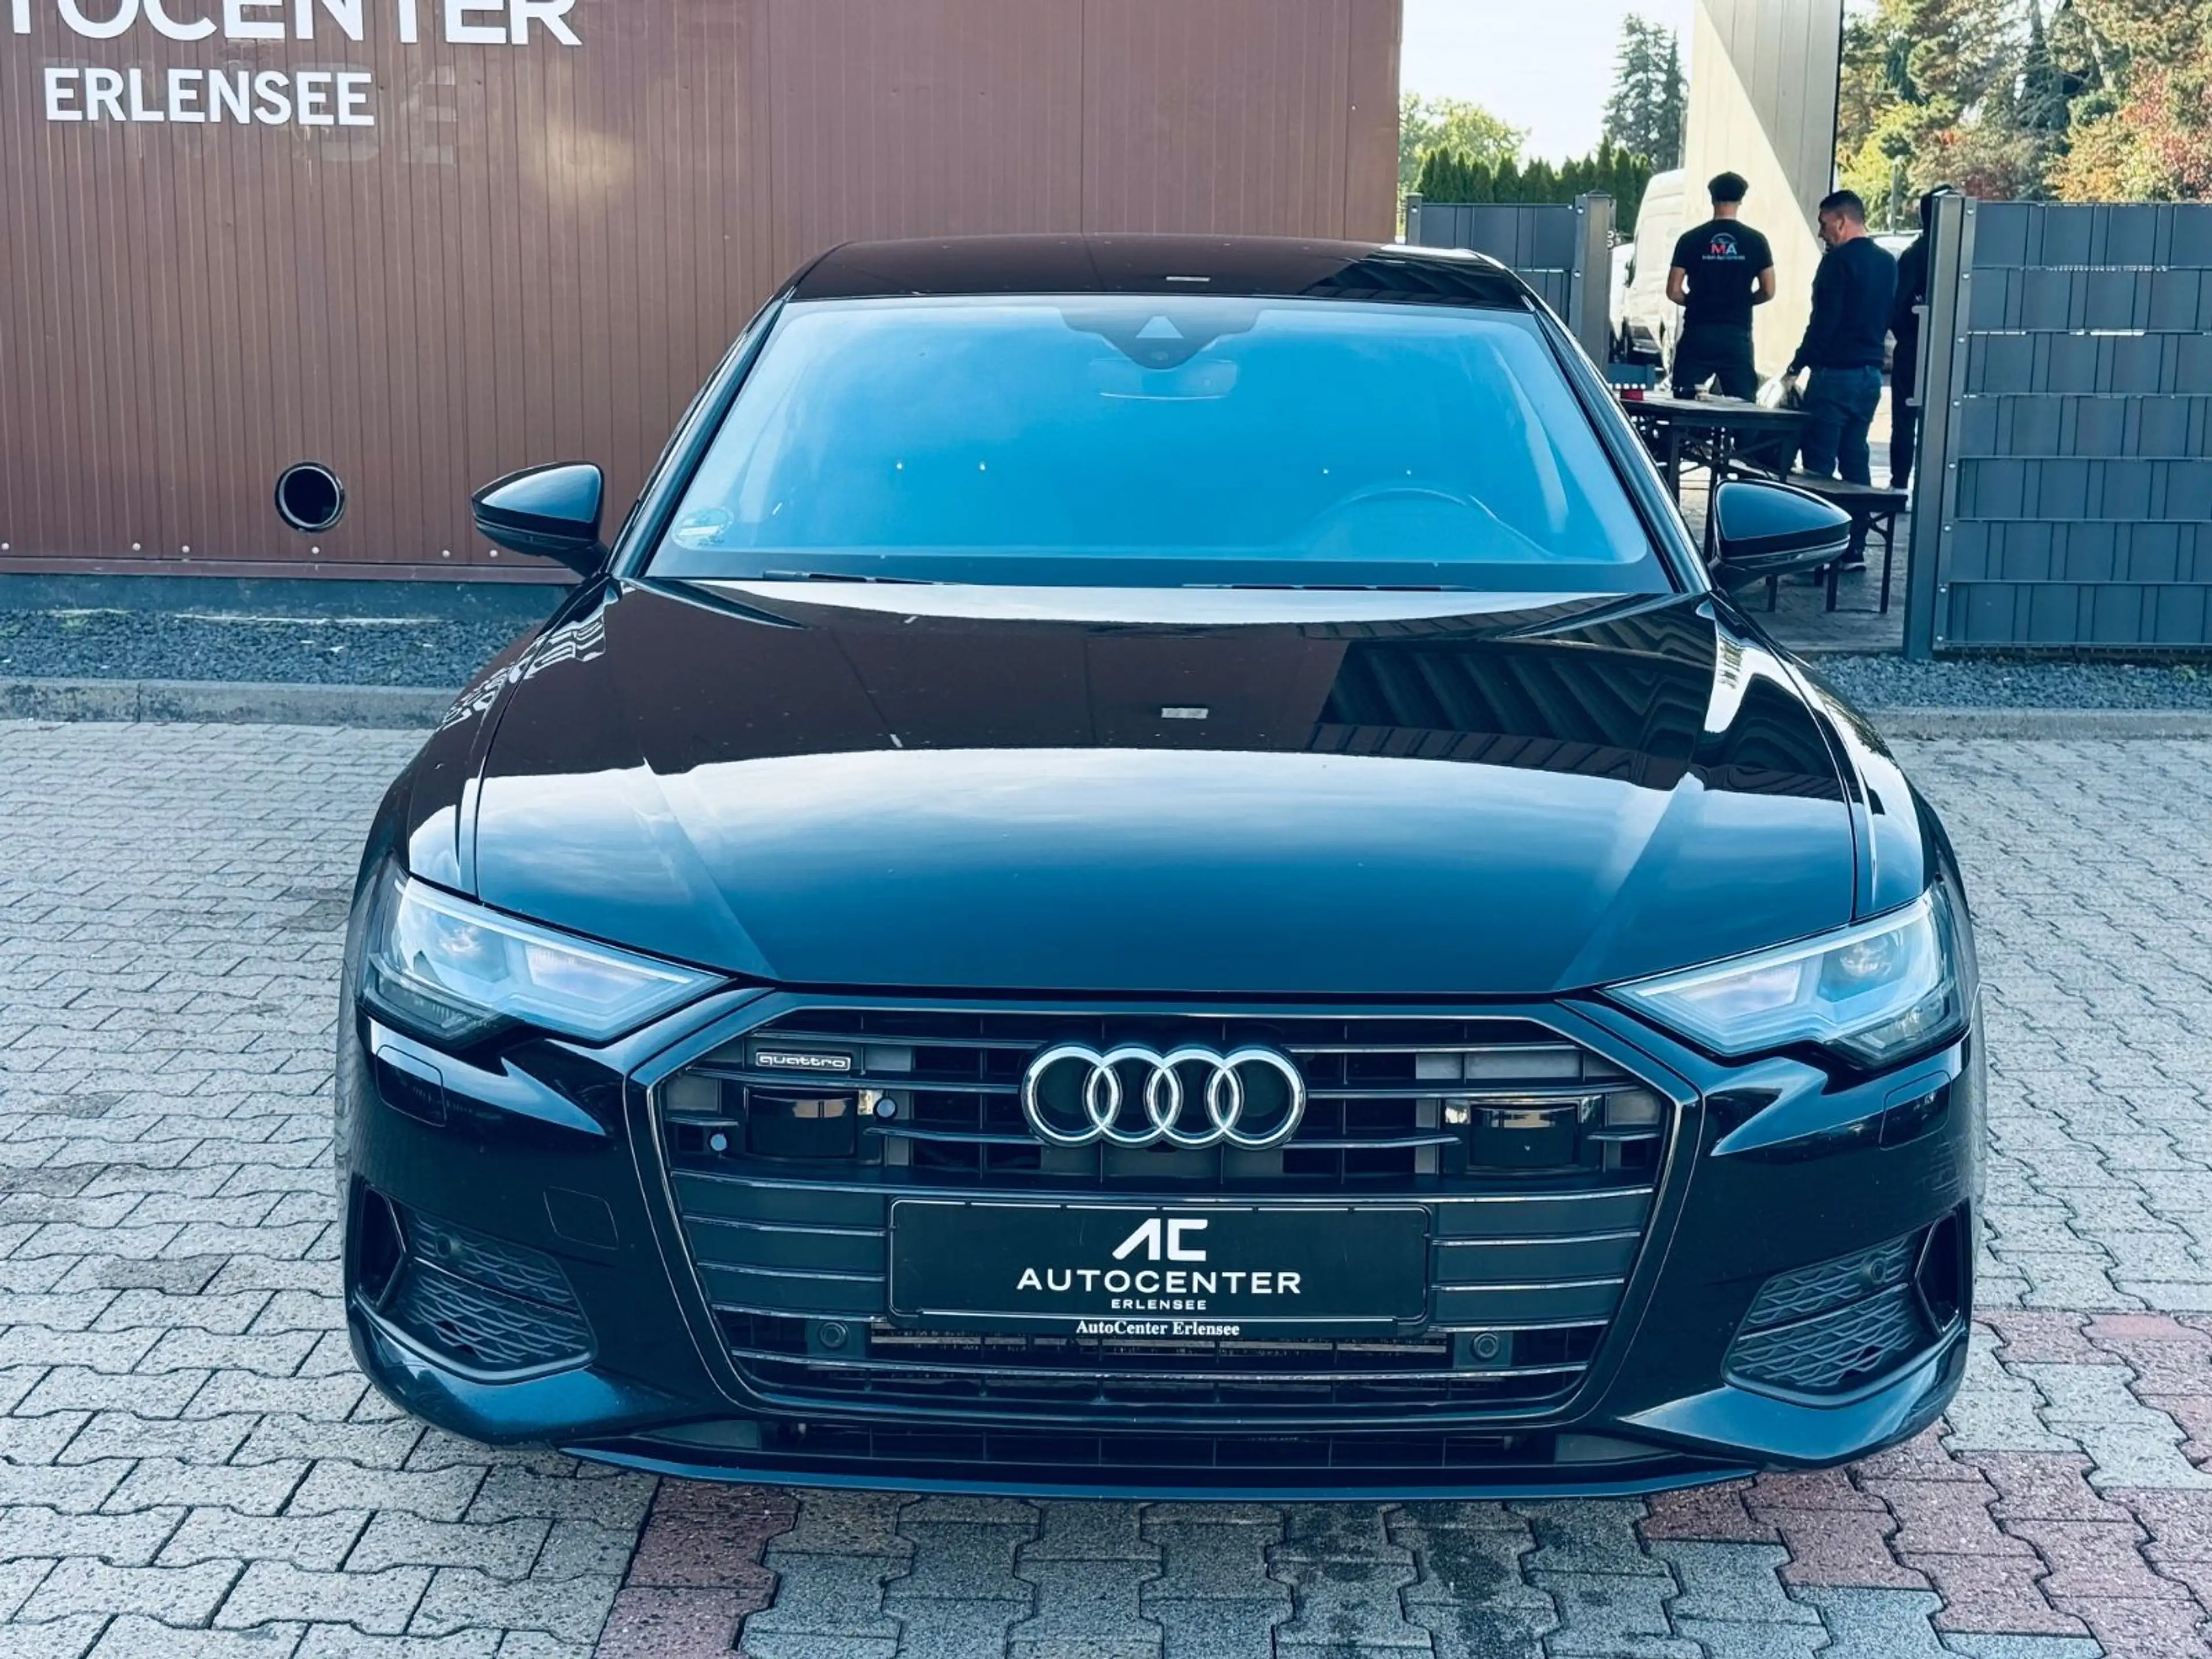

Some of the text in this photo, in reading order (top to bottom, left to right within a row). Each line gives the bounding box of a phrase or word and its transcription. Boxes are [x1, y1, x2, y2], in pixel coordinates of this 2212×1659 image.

[44, 67, 374, 126] ERLENSEE
[1711, 243, 1737, 255] MA
[759, 1055, 846, 1067] quattro
[1112, 1218, 1208, 1262] AC
[1017, 1268, 1301, 1294] AUTOCENTER
[1111, 1298, 1206, 1310] ERLENSEE
[1076, 1320, 1240, 1336] AutoCenter Erlensee
